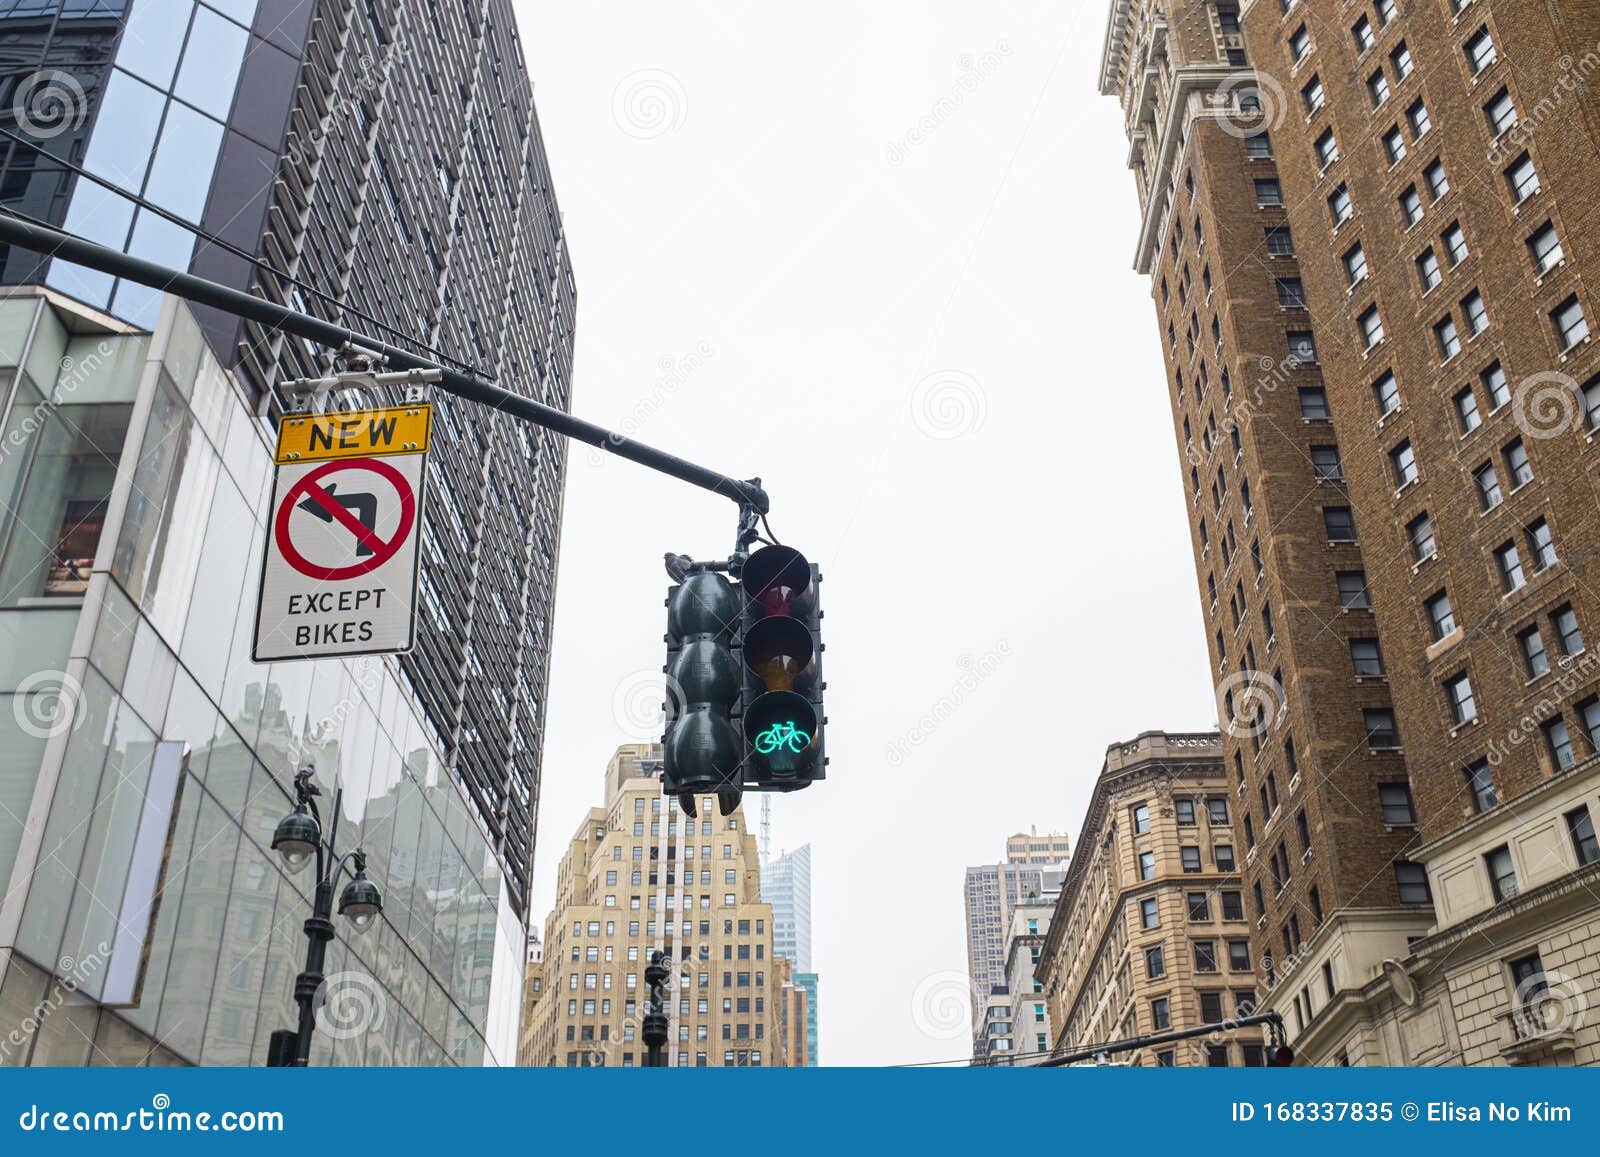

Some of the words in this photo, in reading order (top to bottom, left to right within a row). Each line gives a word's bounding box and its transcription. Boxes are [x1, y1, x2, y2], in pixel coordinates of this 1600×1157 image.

[310, 417, 397, 451] NEW
[288, 588, 386, 615] EXCEPT
[295, 620, 373, 646] BIKES
